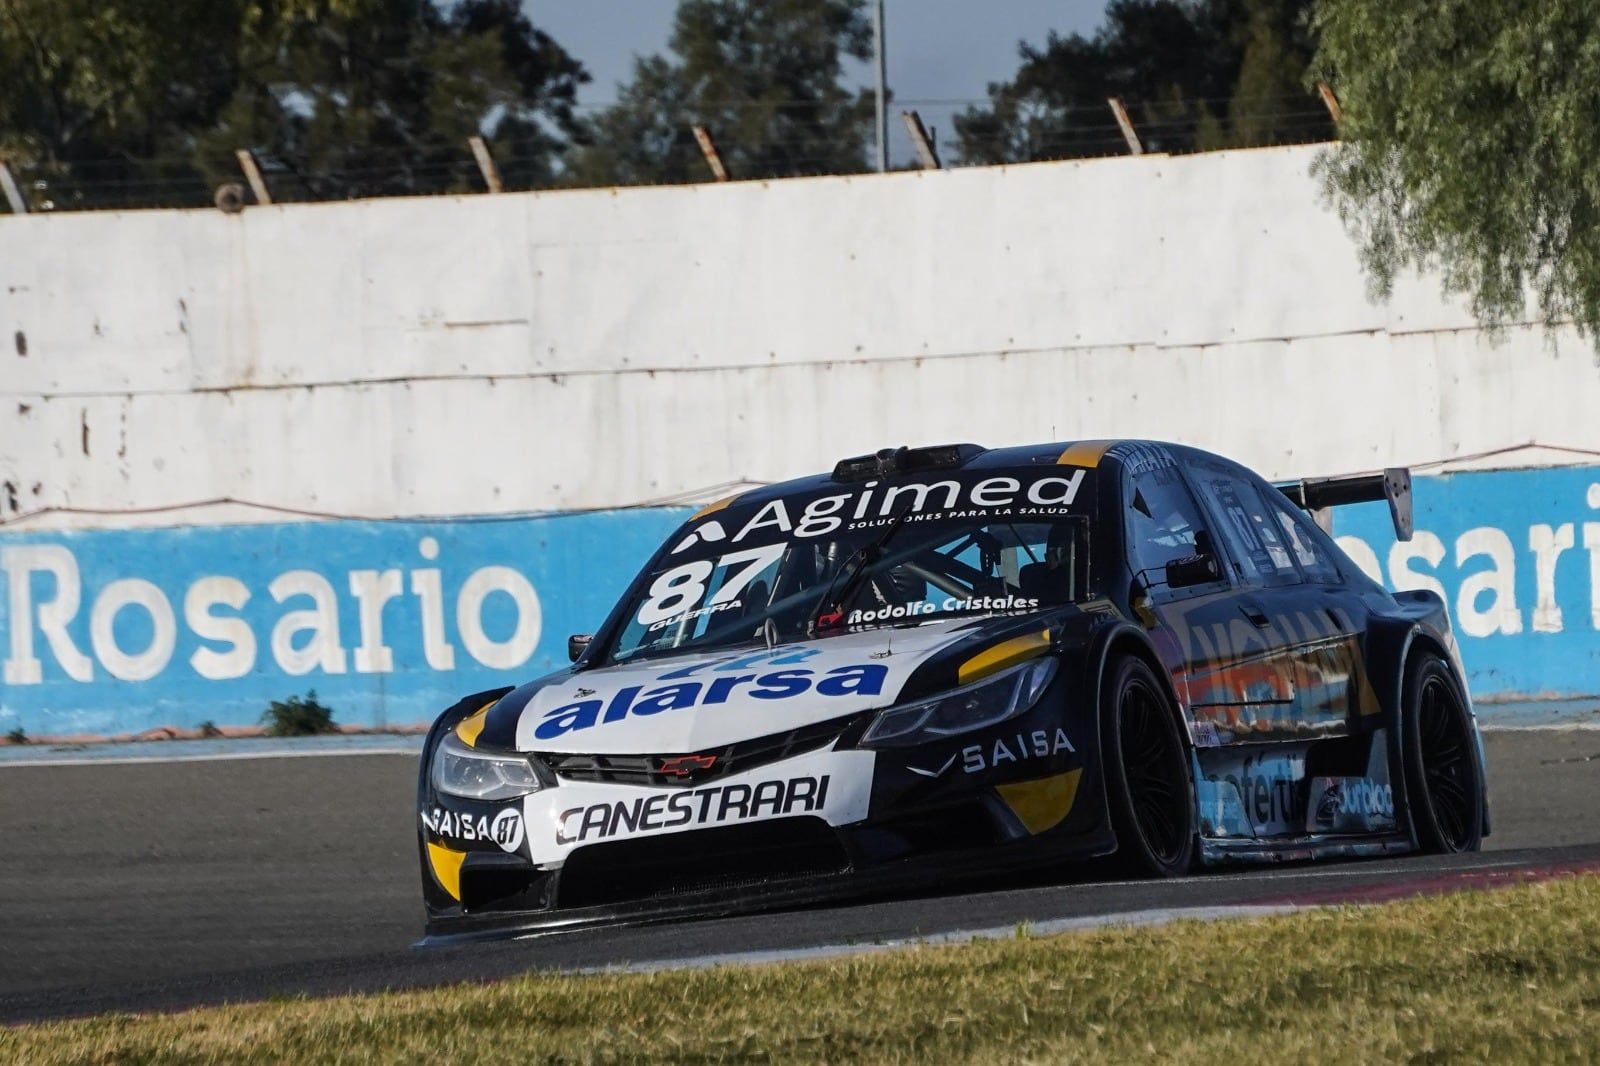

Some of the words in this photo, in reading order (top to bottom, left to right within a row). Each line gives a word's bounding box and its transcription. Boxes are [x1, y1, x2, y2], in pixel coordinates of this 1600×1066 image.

[731, 469, 1087, 539] Agimed
[847, 512, 942, 531] SOLUCONES
[948, 508, 987, 519] PARA
[994, 507, 1012, 516] LA
[1018, 506, 1069, 515] SALUD
[1, 536, 543, 686] Rosario
[637, 541, 789, 626] 87
[847, 600, 936, 625] Rodolfo
[942, 595, 1039, 611] Cristales
[649, 599, 742, 632] GUERRA
[534, 664, 889, 740] alarsa
[961, 728, 1076, 774] SAISA
[496, 815, 520, 845] 87
[555, 775, 831, 847] CANESTRARI
